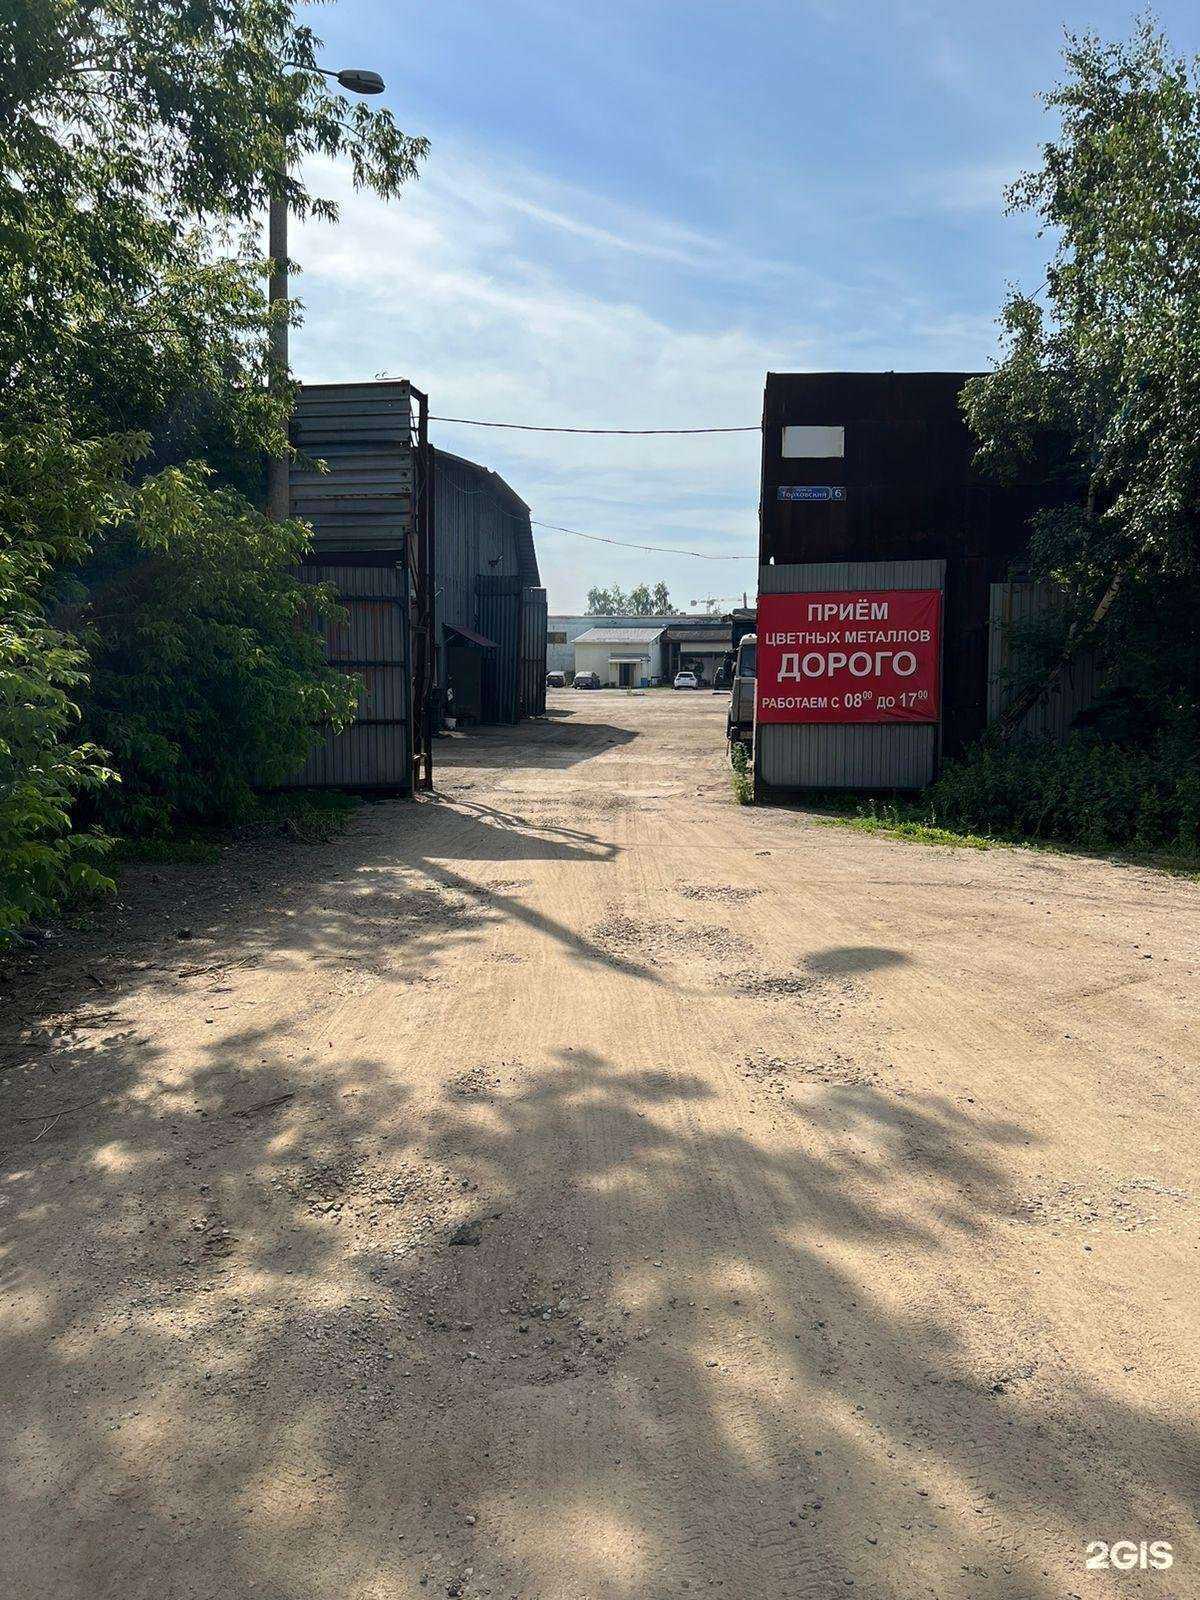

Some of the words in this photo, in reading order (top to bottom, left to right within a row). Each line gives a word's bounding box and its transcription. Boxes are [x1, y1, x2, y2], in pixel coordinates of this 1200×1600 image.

[834, 489, 842, 498] 6
[807, 599, 889, 622] ПРИЁМ
[765, 631, 841, 646] ЦВЕТНЫХ
[844, 629, 931, 643] МЕТАЛЛОВ
[777, 651, 918, 682] ДОРОГО
[762, 696, 828, 709] РАБОТАЕМ
[876, 696, 896, 709] ДО
